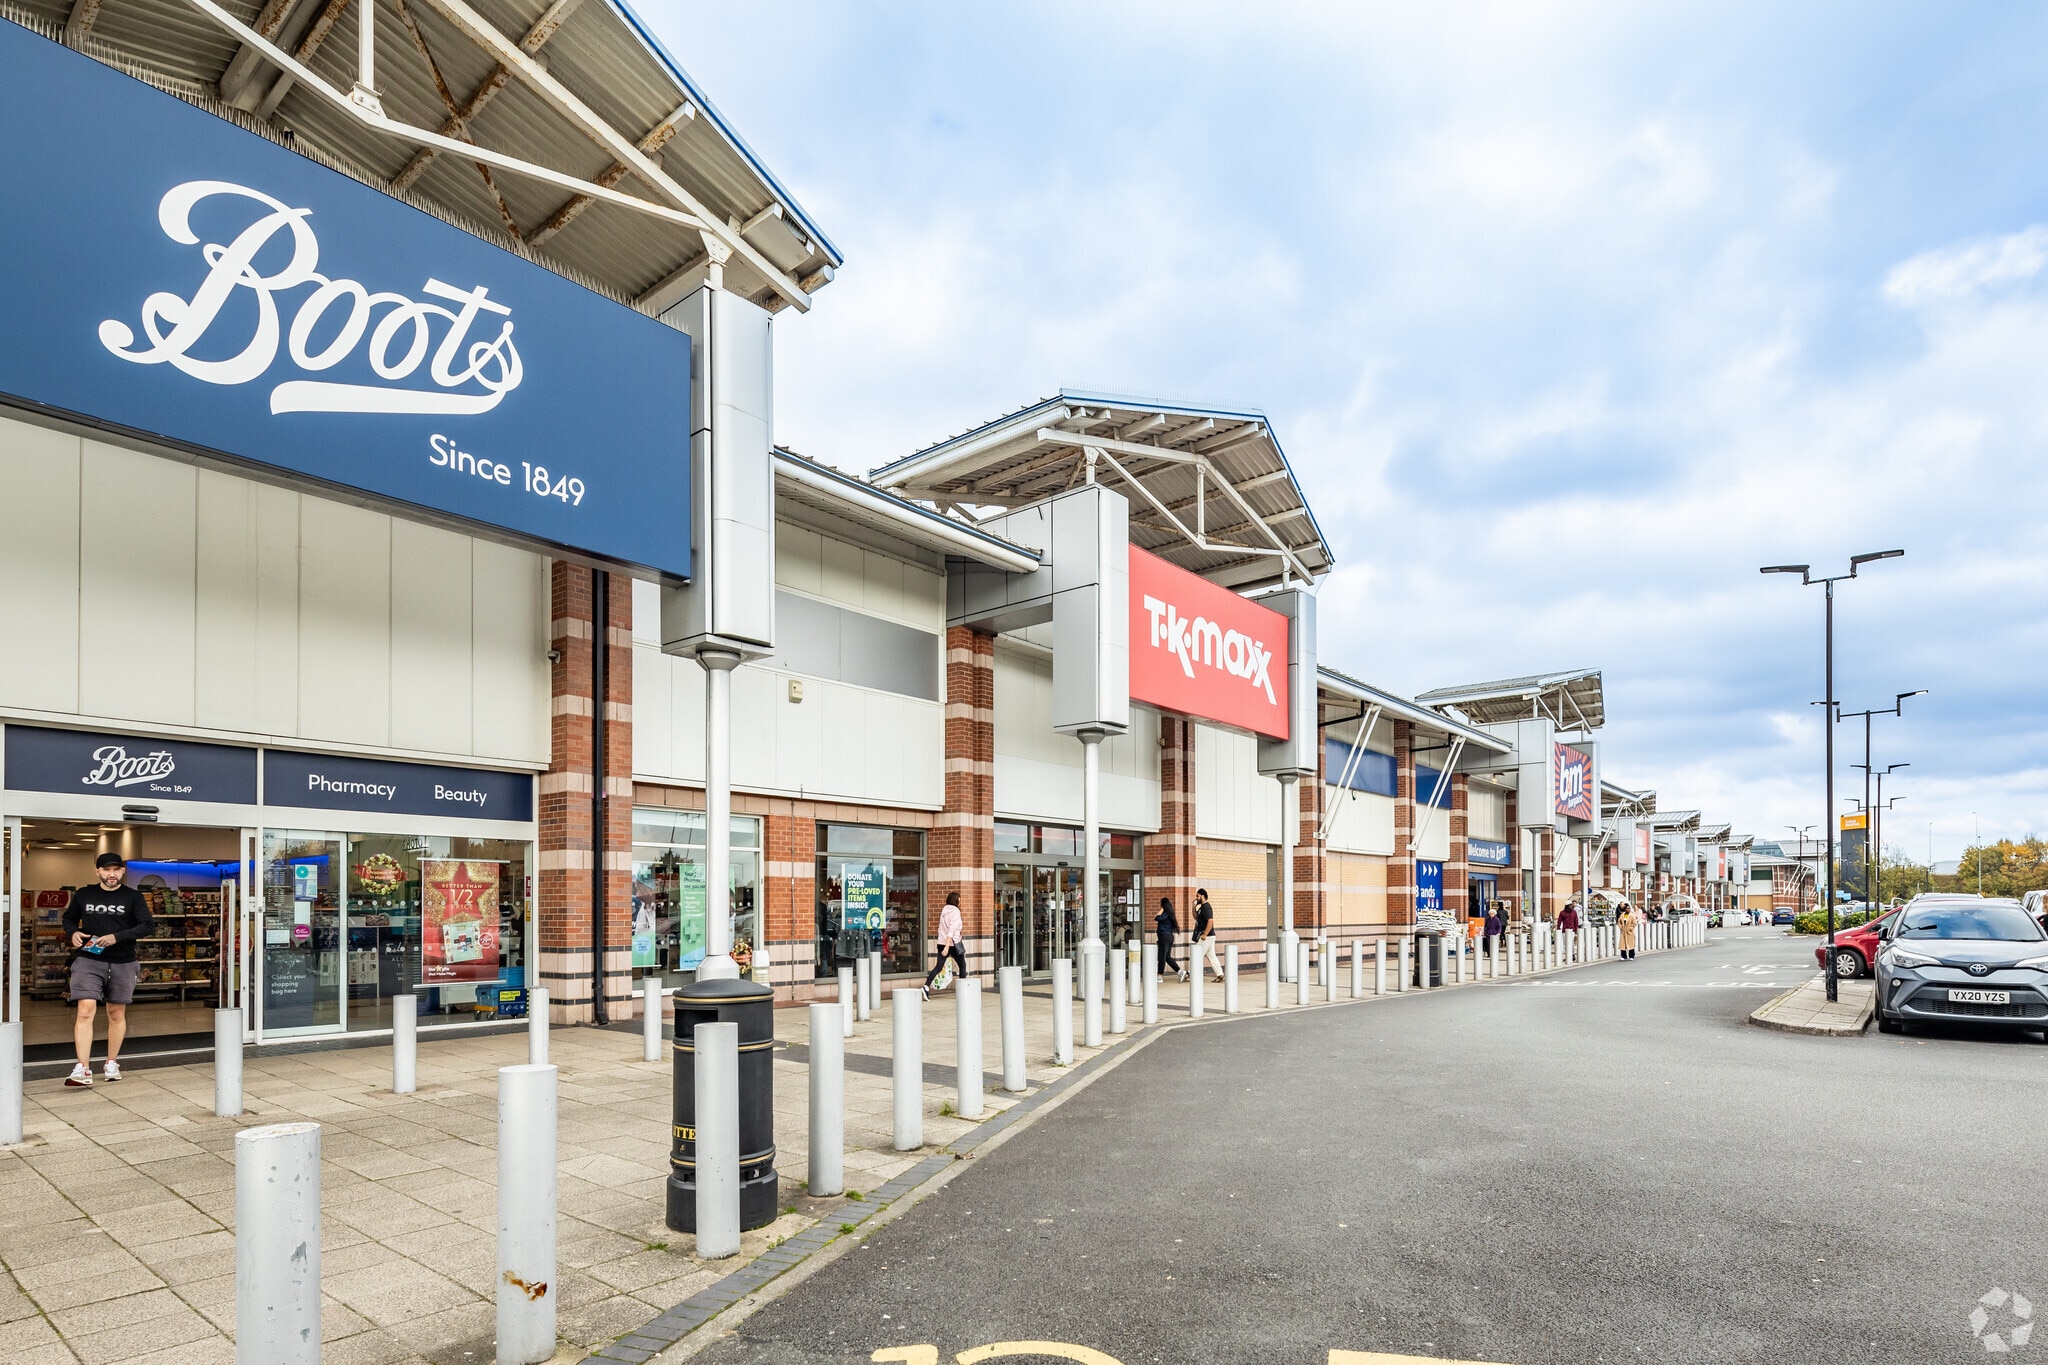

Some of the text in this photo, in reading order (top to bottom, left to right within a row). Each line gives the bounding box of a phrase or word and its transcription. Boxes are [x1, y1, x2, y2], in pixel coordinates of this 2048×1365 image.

[97, 179, 524, 415] Boots
[429, 433, 586, 507] Since 1849
[81, 745, 176, 788] Boots
[150, 783, 193, 794] Since 1849
[308, 773, 488, 807] Pharmacy Beauty
[1468, 843, 1489, 859] Welcome
[1489, 846, 1495, 859] to
[847, 873, 873, 881] DONATE
[847, 880, 865, 888] YOUR
[450, 889, 474, 904] 1/2
[847, 887, 881, 895] PRE-LOVED
[1415, 884, 1436, 898] Bands
[85, 903, 126, 914] BOSS
[847, 901, 869, 909] INSIDE
[1953, 991, 2006, 1002] YX20 YZS
